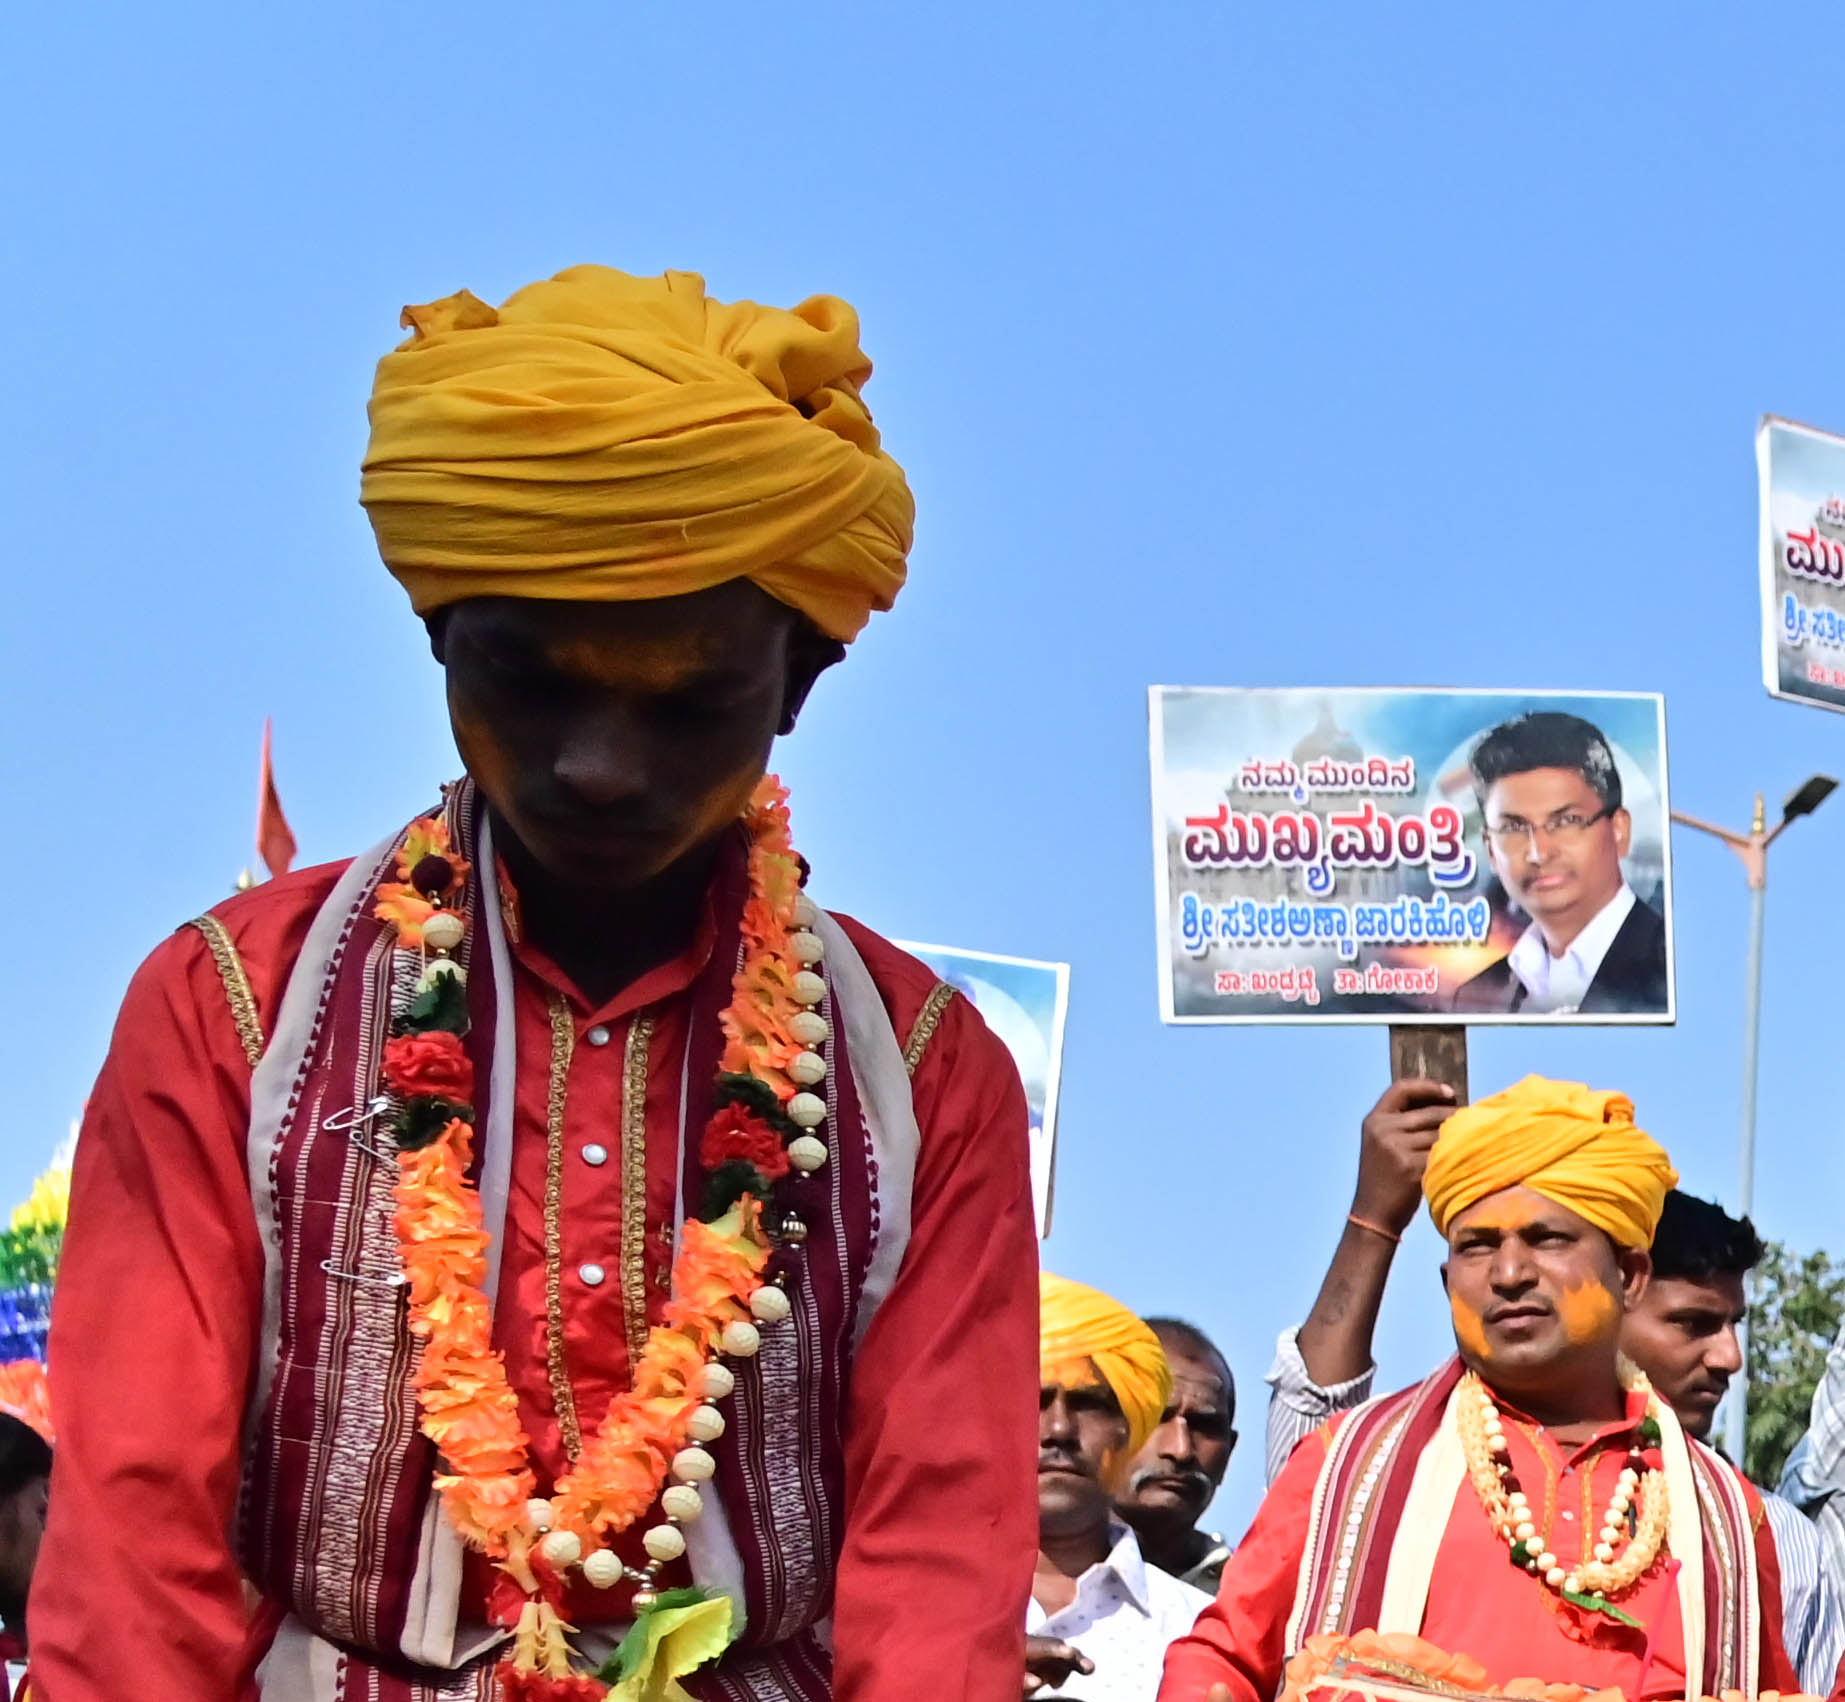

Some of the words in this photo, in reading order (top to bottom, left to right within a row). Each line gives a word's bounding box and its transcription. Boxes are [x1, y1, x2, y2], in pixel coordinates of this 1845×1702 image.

[1242, 760, 1304, 800] ನಮ್ಮ
[1307, 759, 1412, 788] ಮುಂದಿನ
[1184, 803, 1474, 890] ಮುಖ್ಯಮಂತ್ರಿ
[1182, 895, 1214, 951] ಶ್ರೀ
[1355, 895, 1486, 939] ಜಾರಕಿಹೊಳಿ
